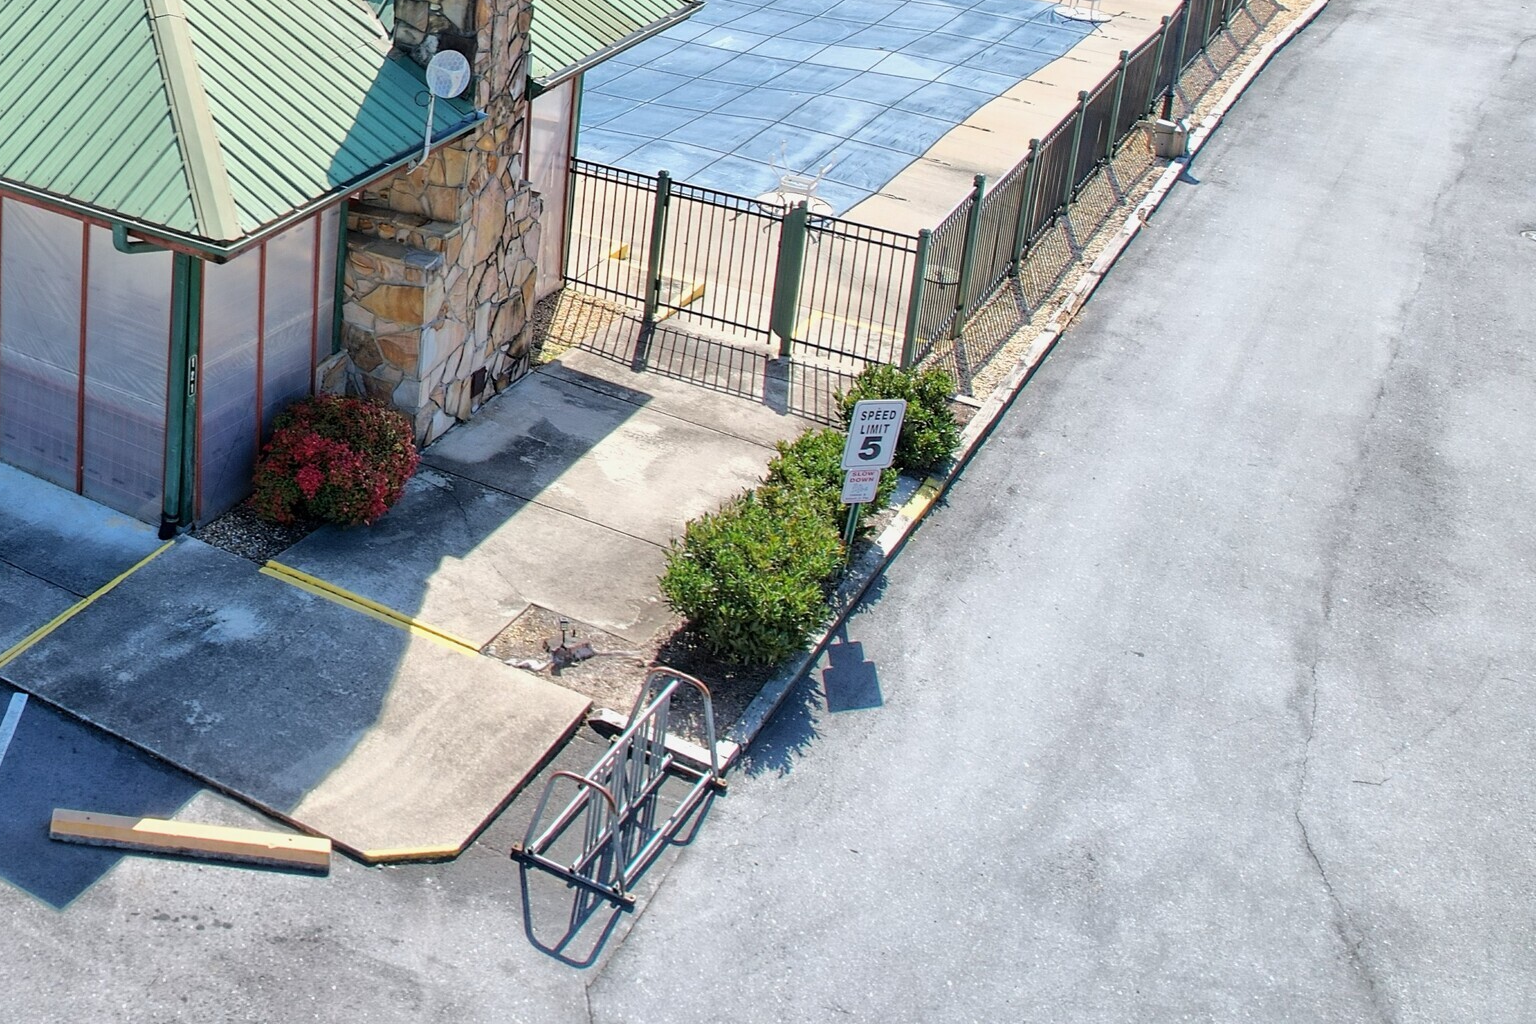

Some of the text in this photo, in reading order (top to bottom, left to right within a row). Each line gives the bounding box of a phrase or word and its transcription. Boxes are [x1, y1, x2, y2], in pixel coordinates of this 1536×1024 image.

[860, 410, 897, 421] SPEED
[860, 423, 890, 435] LIMIT
[858, 436, 883, 461] 5
